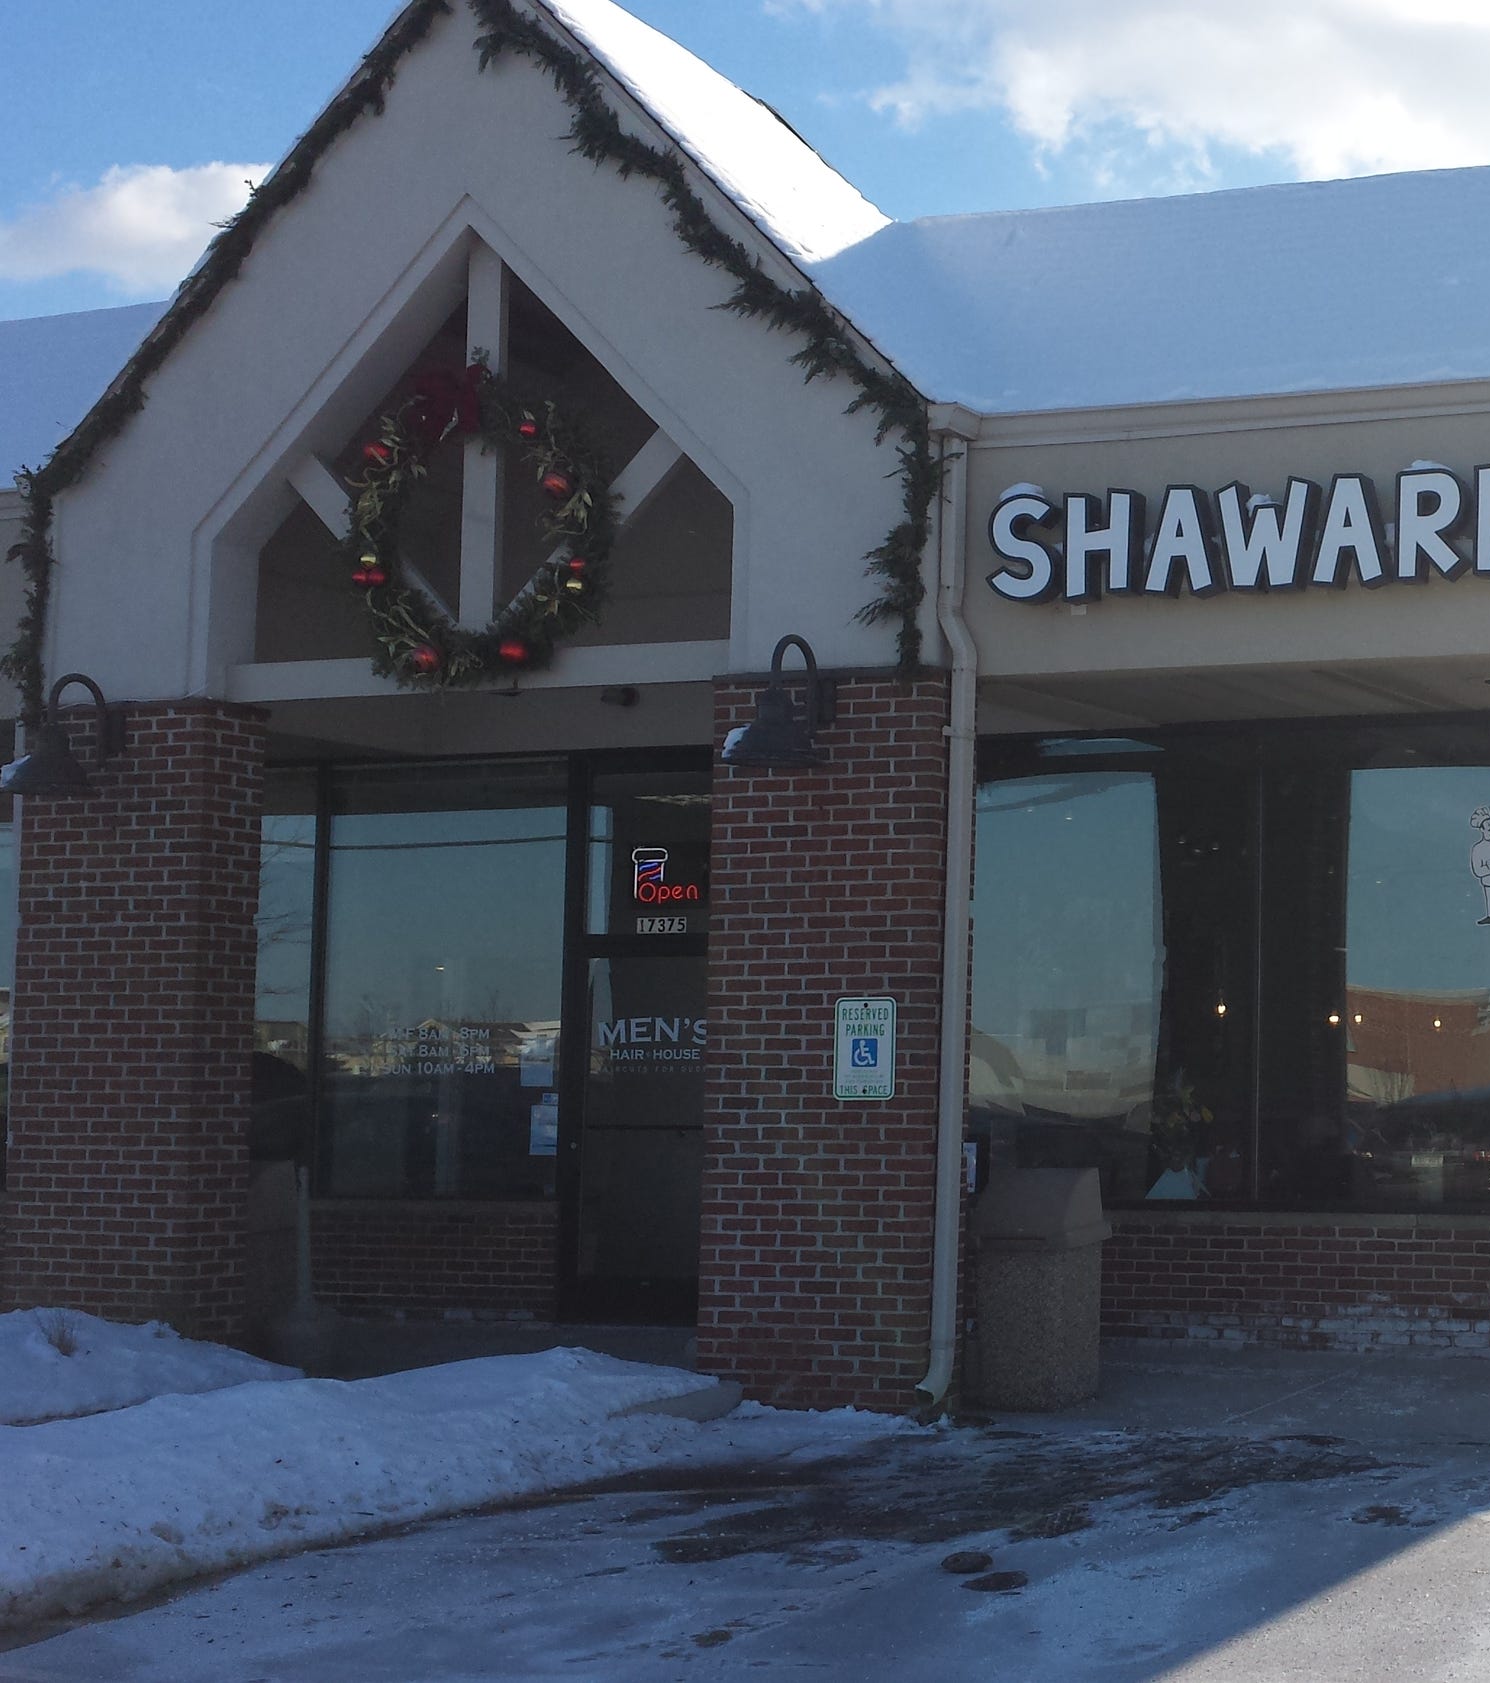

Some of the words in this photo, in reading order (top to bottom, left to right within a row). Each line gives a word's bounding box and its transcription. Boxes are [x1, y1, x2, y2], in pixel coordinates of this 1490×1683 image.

[638, 881, 698, 904] Open
[640, 918, 686, 932] 17375
[842, 1007, 889, 1021] RESERVED
[598, 1016, 707, 1046] MEN'S
[845, 1023, 885, 1036] PARKING
[610, 1048, 645, 1060] HAIR
[653, 1048, 701, 1060] HOUSE
[383, 1063, 411, 1074] SUN
[840, 1084, 858, 1095] THIS
[863, 1084, 888, 1095] SPACE
